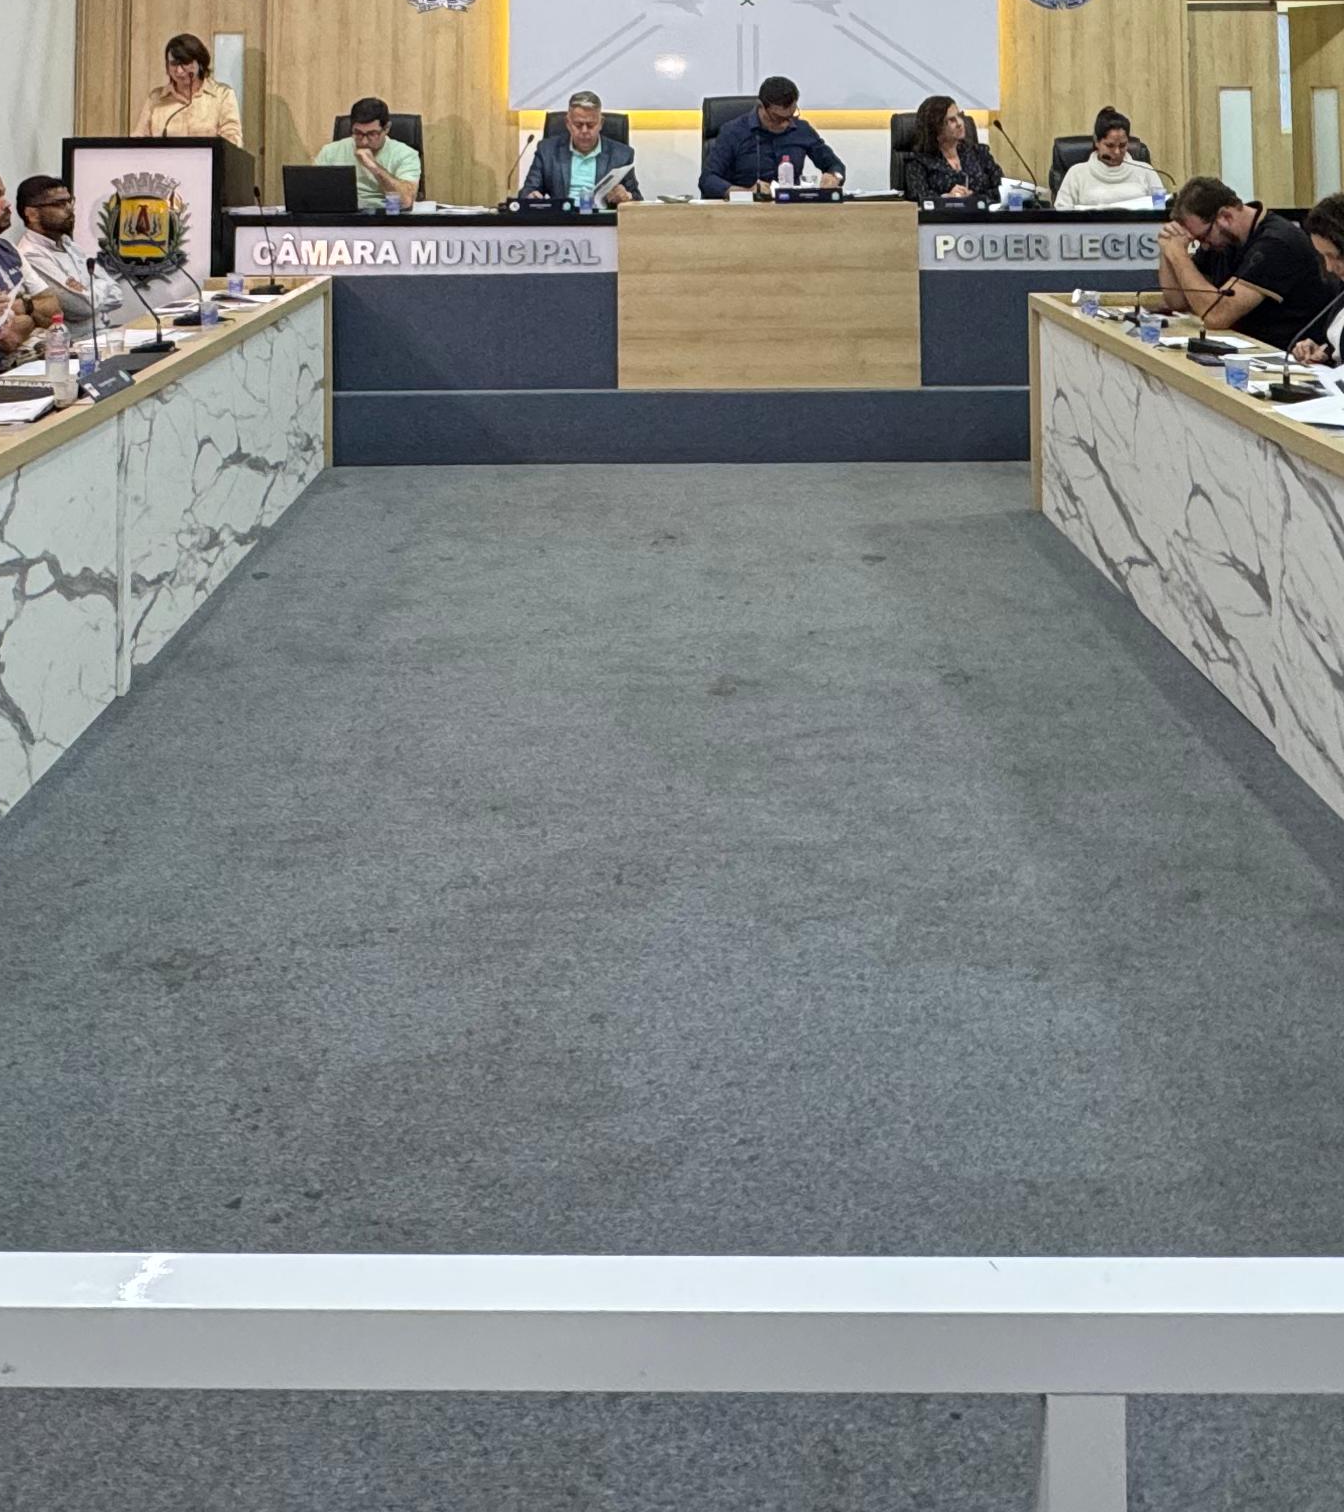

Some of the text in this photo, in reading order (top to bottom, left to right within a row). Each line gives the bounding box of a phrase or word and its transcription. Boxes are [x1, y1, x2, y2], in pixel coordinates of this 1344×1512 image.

[253, 232, 601, 267] CÂMARA MUNICIPAL
[935, 232, 1162, 262] PODER LEGIS
